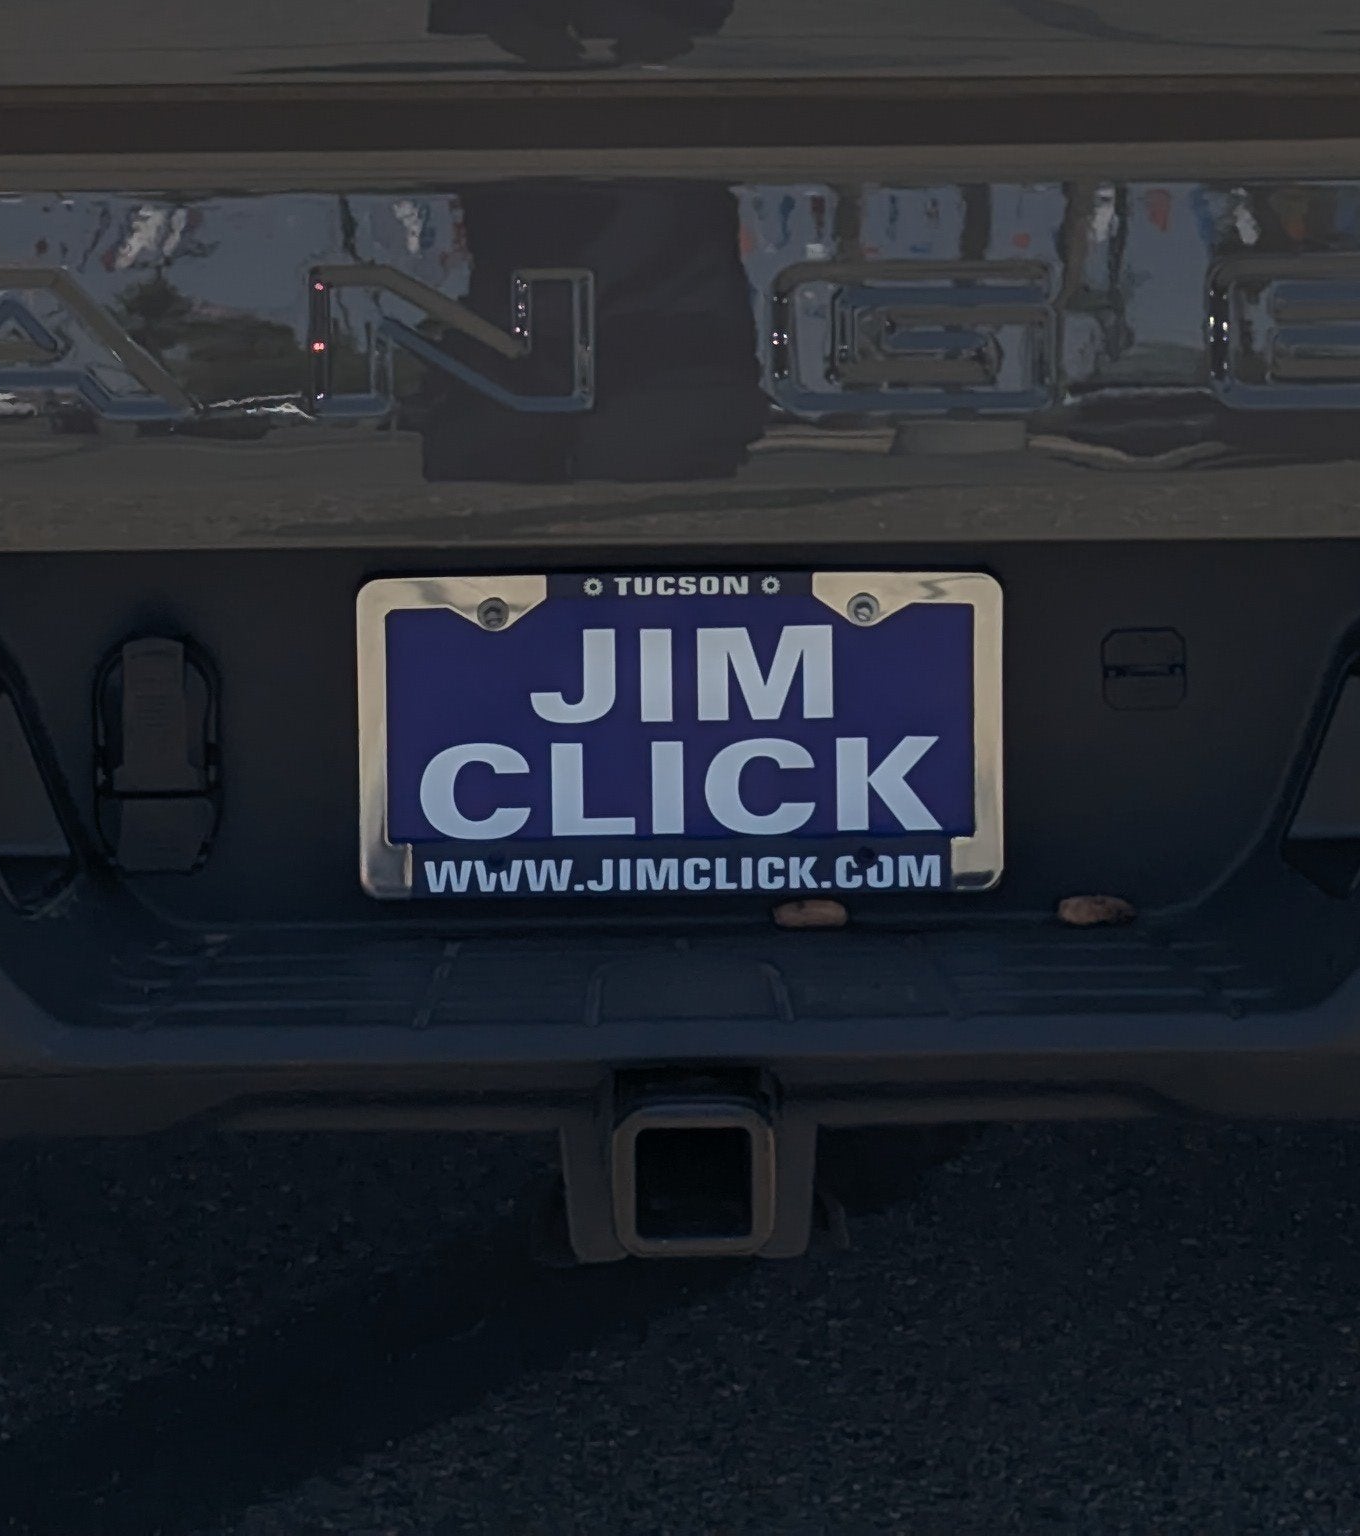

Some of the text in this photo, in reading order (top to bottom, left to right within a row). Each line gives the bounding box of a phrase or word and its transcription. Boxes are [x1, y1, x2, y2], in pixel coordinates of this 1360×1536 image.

[613, 575, 749, 596] TUCSON
[530, 624, 834, 724] JIM
[419, 735, 943, 840] CLICK
[423, 855, 942, 894] WWW.JIMCLICK.COM
